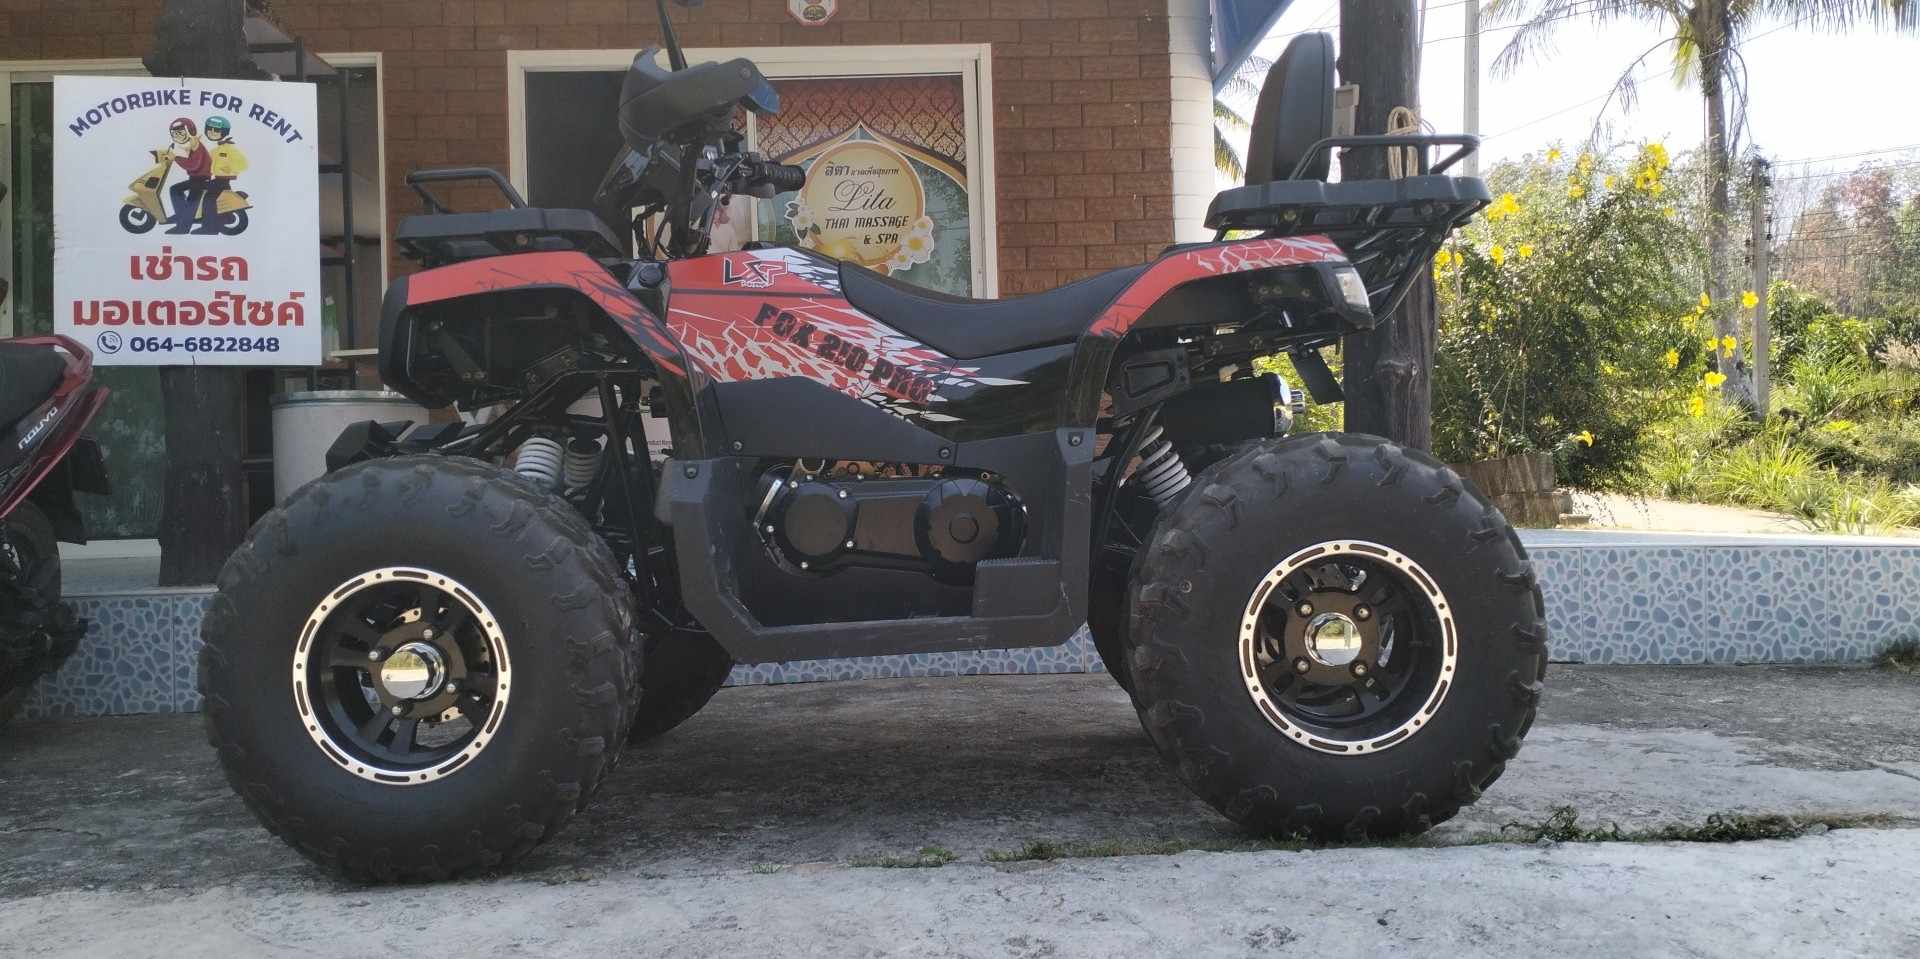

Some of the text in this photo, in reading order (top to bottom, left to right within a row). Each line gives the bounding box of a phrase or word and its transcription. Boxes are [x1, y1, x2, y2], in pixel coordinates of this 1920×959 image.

[68, 89, 303, 144] MOTORBIKE FOR RENT
[825, 216, 909, 230] THAI MASSAGE
[864, 233, 899, 244] & SPA
[130, 245, 249, 281] เช่ารถ
[754, 303, 818, 349] FOX
[129, 336, 280, 353] 064-6822848
